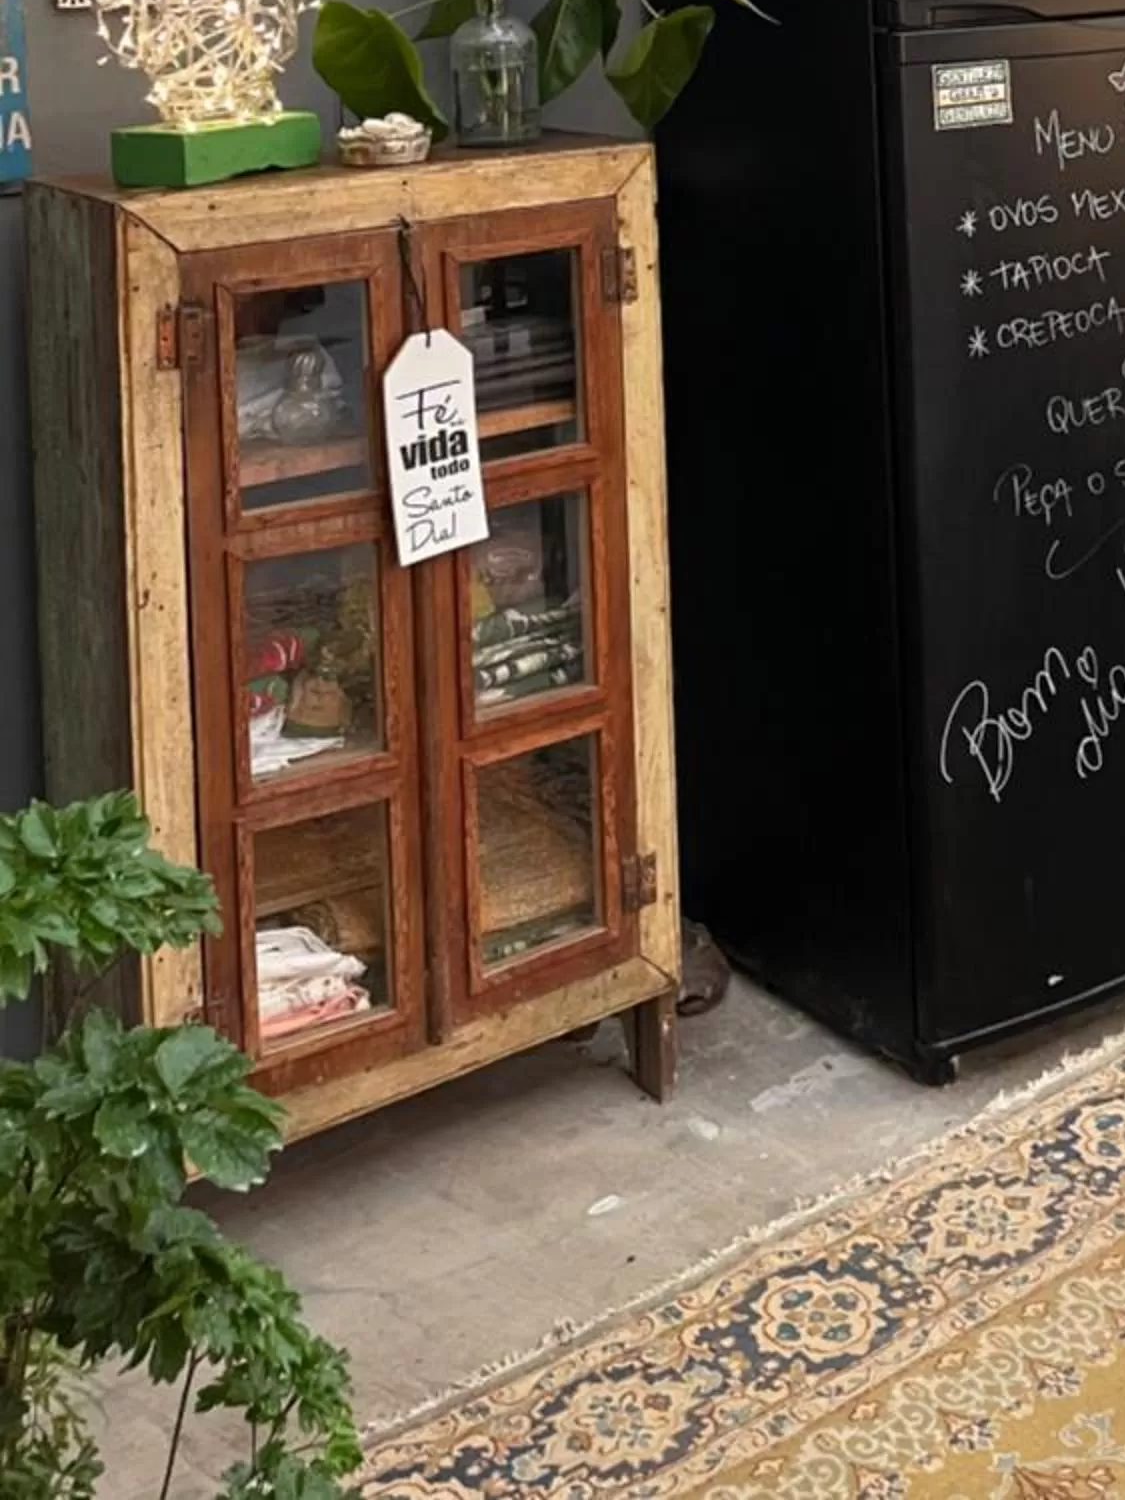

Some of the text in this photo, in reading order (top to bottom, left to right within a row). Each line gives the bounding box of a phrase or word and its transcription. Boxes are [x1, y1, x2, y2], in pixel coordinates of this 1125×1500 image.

[988, 194, 1060, 233] OVOS
[399, 427, 470, 472] vida
[430, 457, 471, 481] todo
[401, 484, 475, 519] Santo
